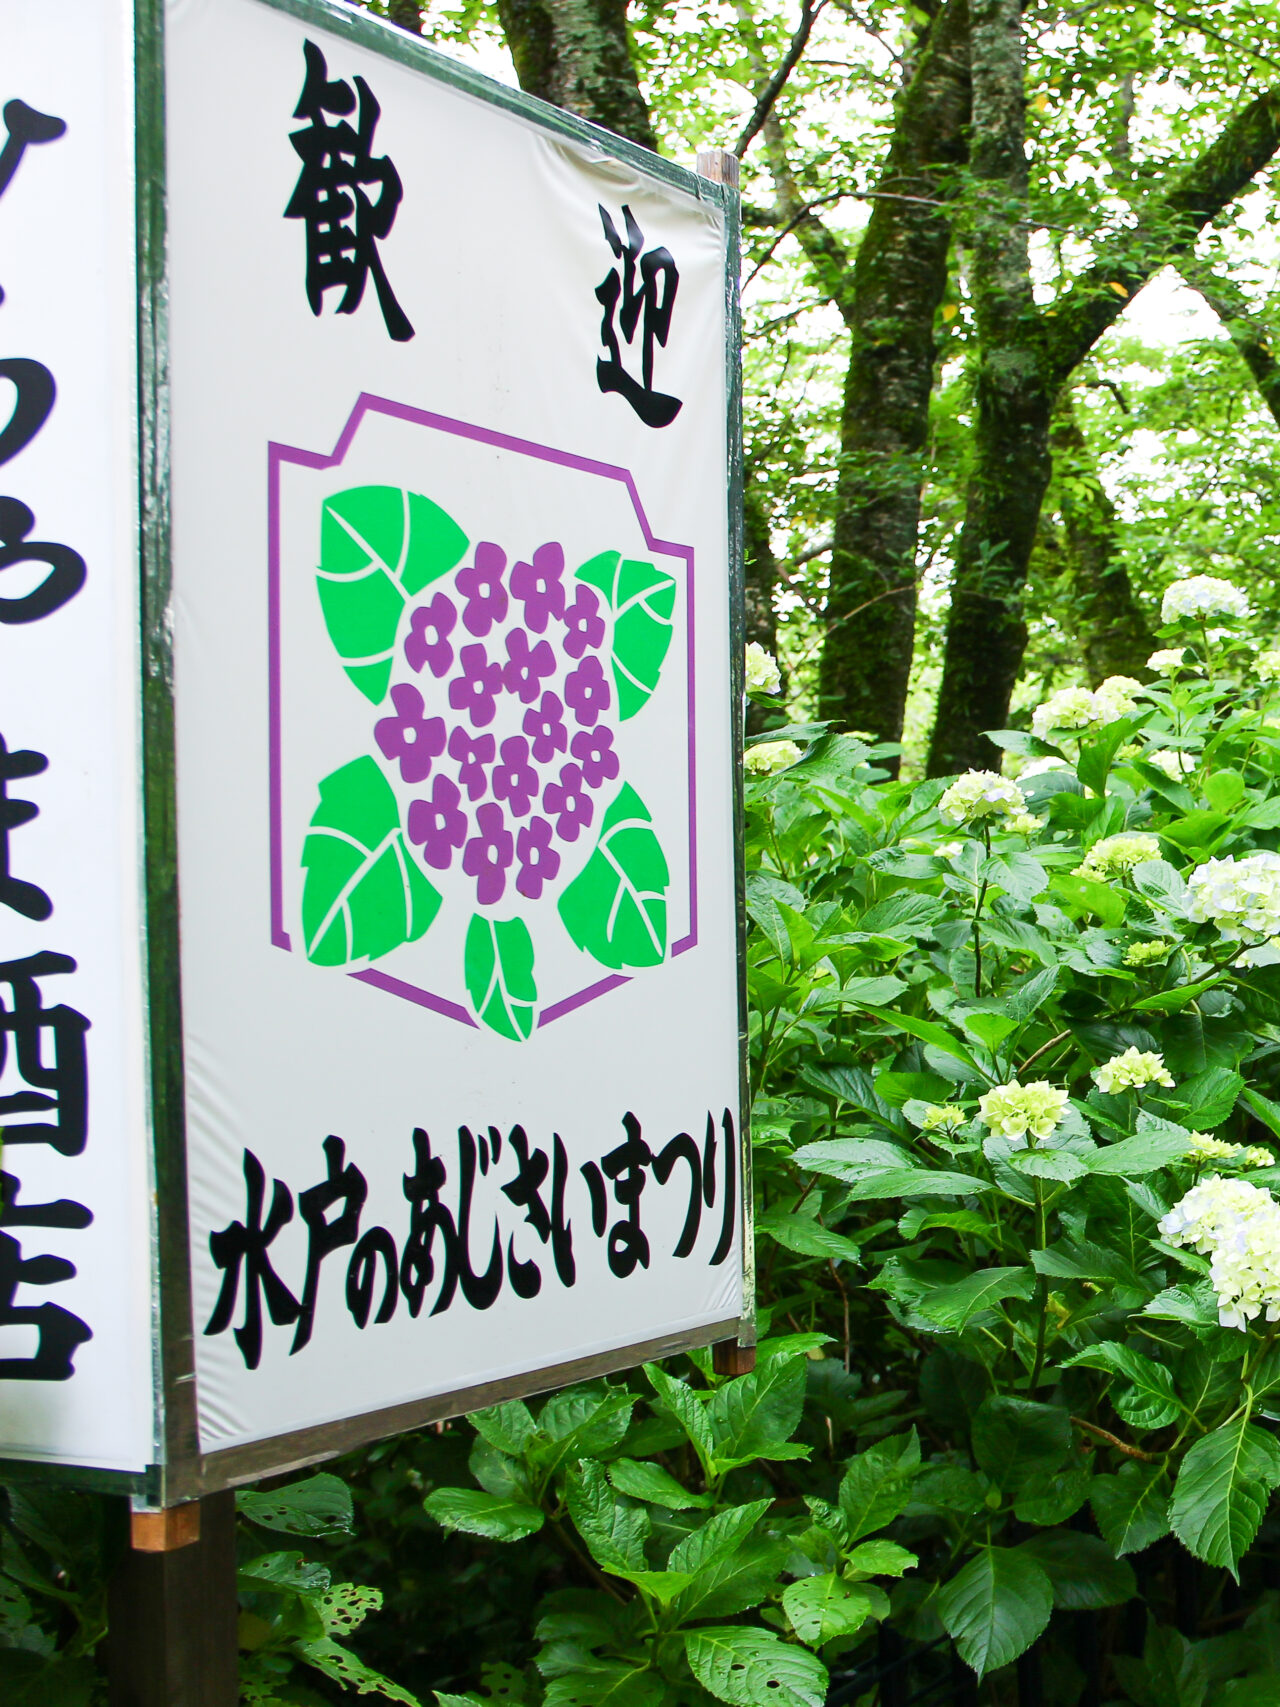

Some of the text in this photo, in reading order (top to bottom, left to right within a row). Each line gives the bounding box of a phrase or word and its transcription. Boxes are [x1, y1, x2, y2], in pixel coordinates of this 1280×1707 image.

[203, 1107, 736, 1370] 水戸のあじさいまつり
